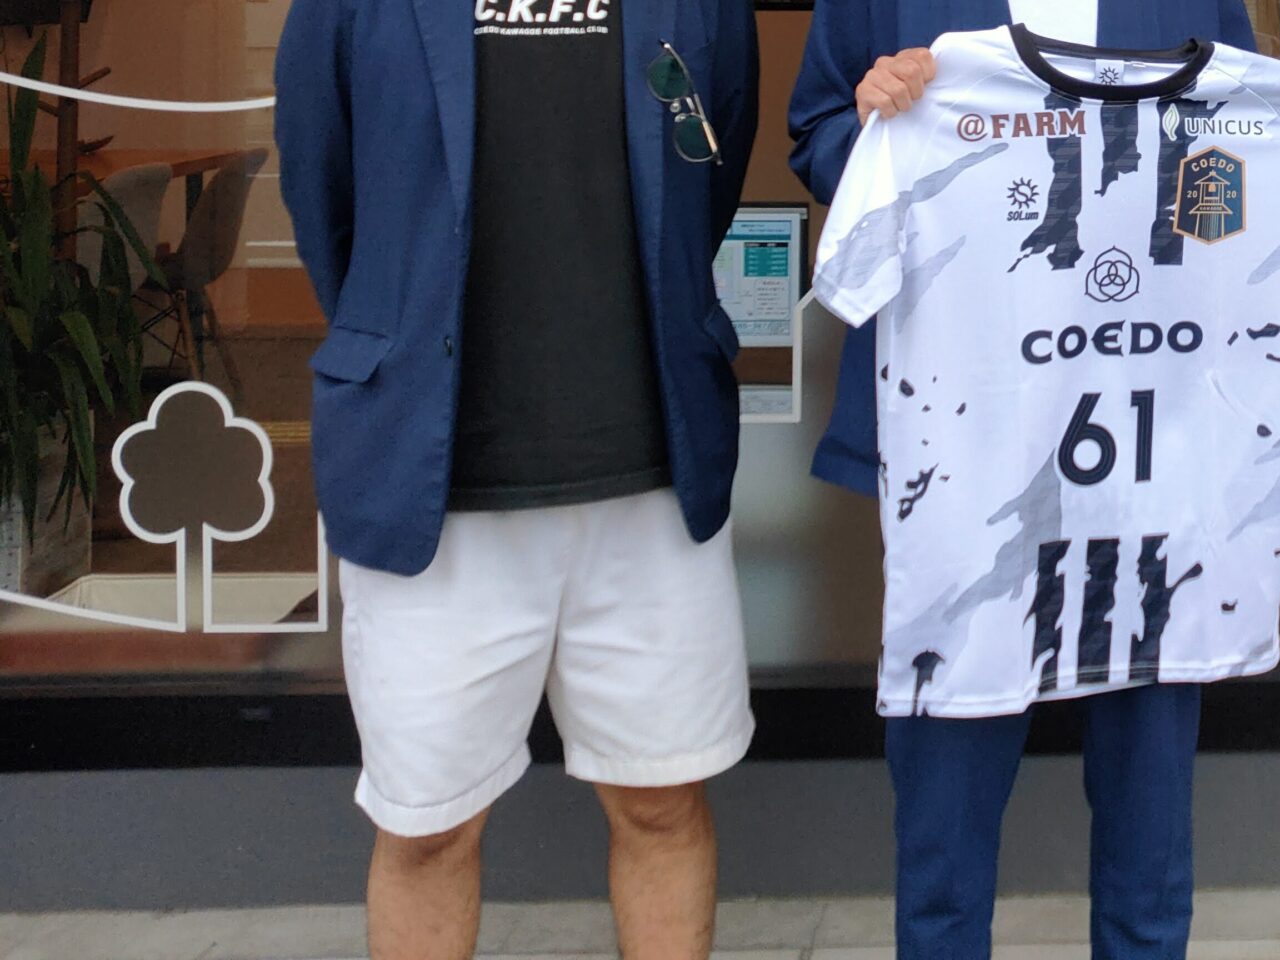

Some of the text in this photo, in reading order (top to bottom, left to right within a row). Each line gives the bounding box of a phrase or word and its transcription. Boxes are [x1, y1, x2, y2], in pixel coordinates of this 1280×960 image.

[542, 27, 586, 35] FOOTBALL
[957, 110, 1087, 141] @FARM
[1184, 116, 1264, 136] UNICUS
[1191, 157, 1236, 173] COEDO
[1186, 190, 1238, 198] 20 20
[1021, 320, 1204, 365] COEDO
[1057, 389, 1155, 486] 61
